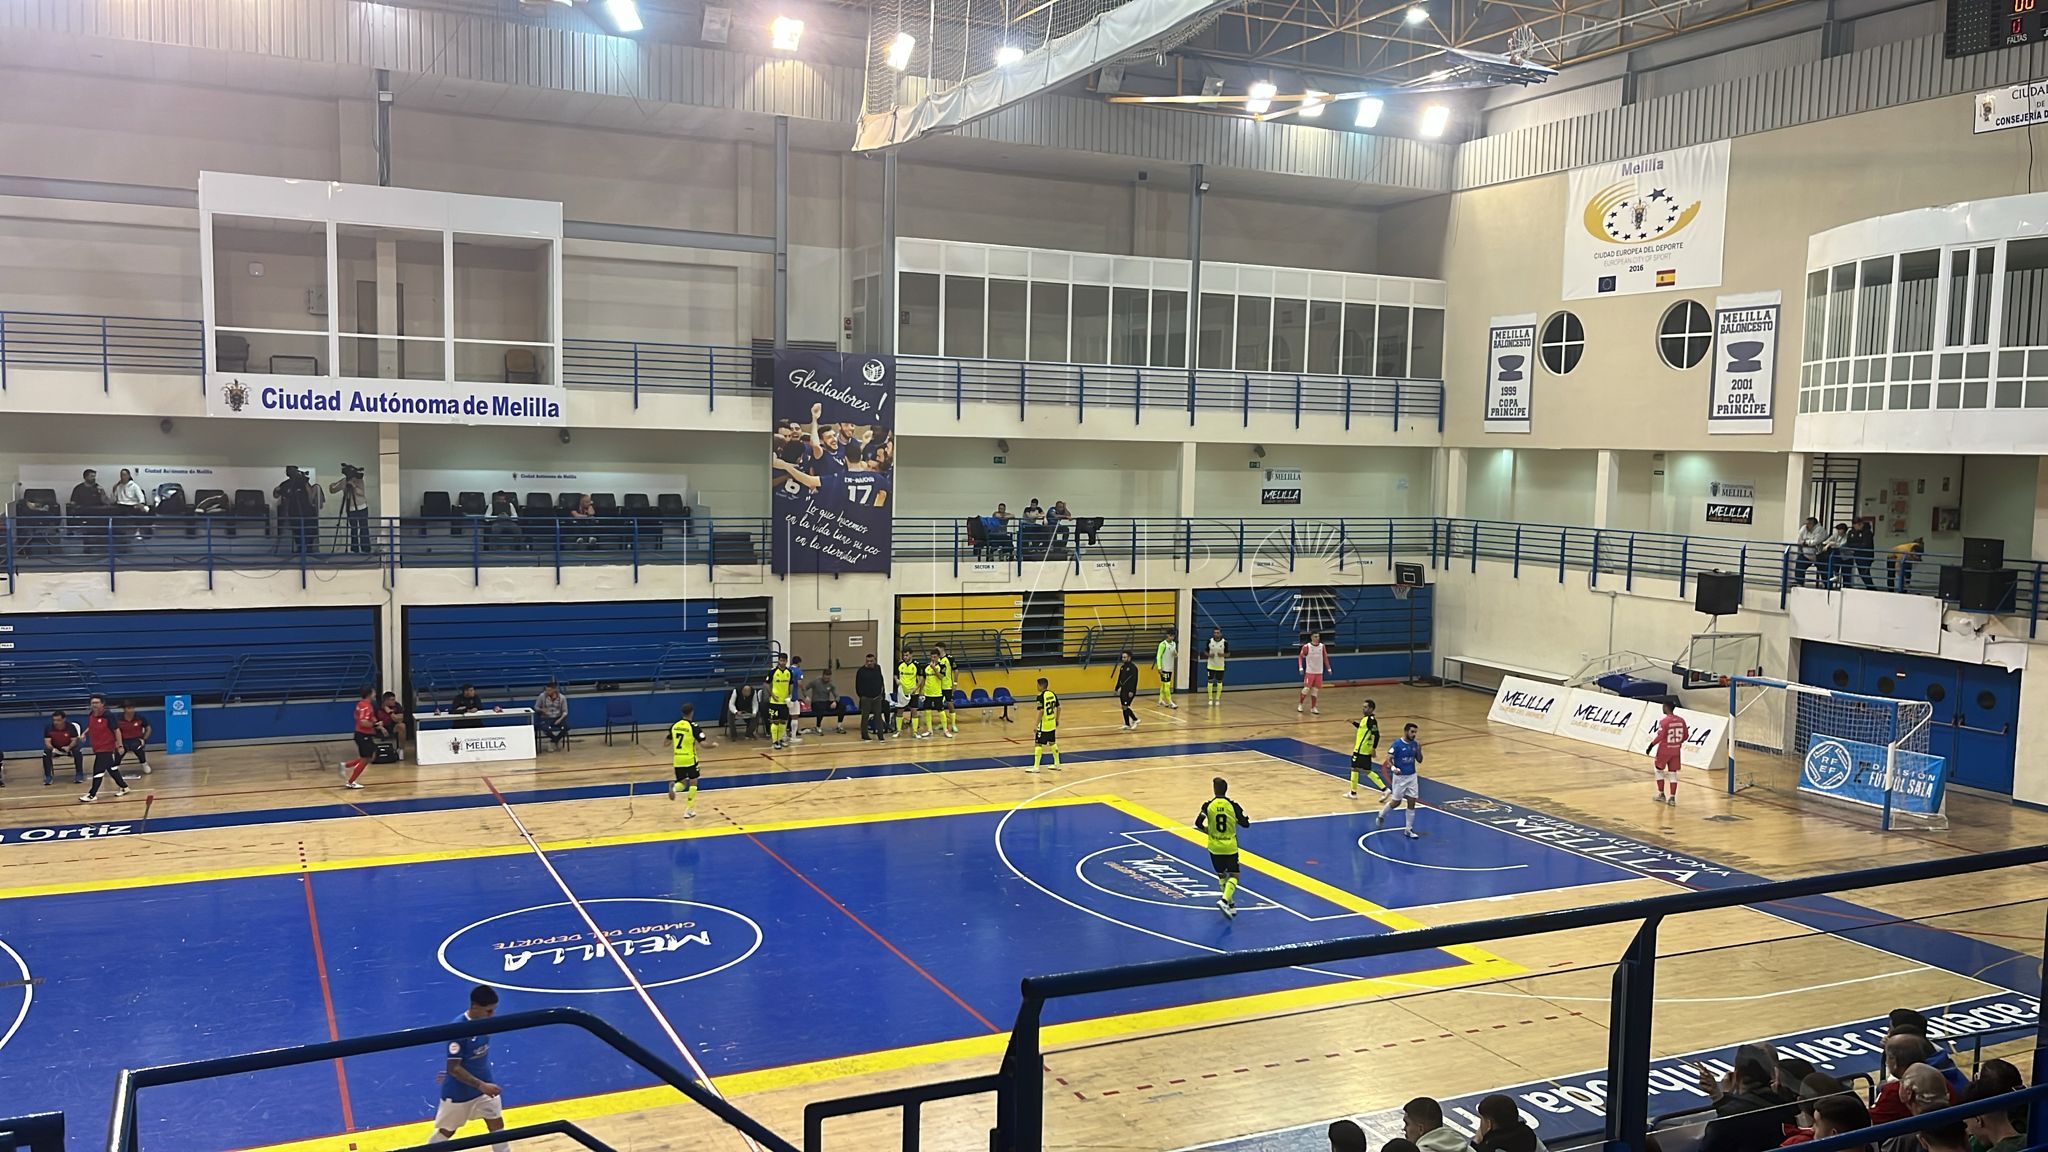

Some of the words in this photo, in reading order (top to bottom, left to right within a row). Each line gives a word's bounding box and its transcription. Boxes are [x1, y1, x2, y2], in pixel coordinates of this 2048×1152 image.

[2006, 34, 2028, 44] FALTAS
[1996, 111, 2041, 126] CONSEJERÍA
[1622, 159, 1664, 176] Melilla
[1594, 251, 1615, 259] CIUDAD
[1616, 248, 1642, 257] EUROPEA
[1644, 246, 1655, 254] DEL
[1656, 242, 1684, 252] DEPORTE
[1604, 258, 1632, 266] EUROPEAN
[1632, 256, 1645, 264] CITY
[1653, 253, 1672, 262] SPORT
[1629, 264, 1644, 272] 2016
[1723, 310, 1771, 323] MELILLA
[1495, 329, 1530, 340] MELILLA
[1720, 321, 1773, 334] BALONCESTO
[1494, 338, 1531, 348] BALONCESTO
[789, 369, 871, 411] Gladiadores
[1501, 386, 1516, 396] 1999
[1732, 379, 1752, 390] 2001
[262, 387, 341, 411] Ciudad
[350, 391, 460, 415] Autónoma
[463, 395, 488, 415] de
[492, 396, 560, 417] Melilla
[1499, 399, 1518, 408] COPA
[1728, 394, 1755, 404] COPA
[1491, 408, 1526, 416] PRINCIPE
[1717, 404, 1766, 414] PRINCIPE
[784, 478, 800, 494] 6
[1722, 489, 1752, 498] MELILLA
[848, 485, 872, 504] 17
[1264, 490, 1300, 500] MELILLA
[1709, 506, 1750, 518] MELILLA
[820, 508, 836, 524] que
[837, 510, 868, 534] hacemos
[786, 514, 797, 525] en
[799, 514, 810, 529] la
[812, 522, 831, 536] vida
[833, 528, 852, 546] tiene
[853, 540, 862, 550] su
[864, 546, 880, 556] eco
[795, 536, 808, 546] en
[809, 535, 821, 550] la
[1502, 690, 1554, 714] MELILLA
[1574, 704, 1632, 728] MELILLA
[676, 732, 684, 749] 7
[1667, 728, 1684, 743] 25
[466, 741, 506, 750] MELILLA
[1907, 780, 1934, 798] SALA
[1216, 814, 1228, 832] 8
[20, 824, 132, 840] Ortiz
[1492, 818, 1699, 882] MELILLA
[1528, 814, 1600, 838] CIUDAD
[1602, 837, 1731, 877] AUTONOMA
[1122, 860, 1224, 897] MELILLA
[628, 921, 695, 935] CIUDAD
[494, 934, 584, 950] DEPORTE
[504, 930, 712, 972] MELILLA
